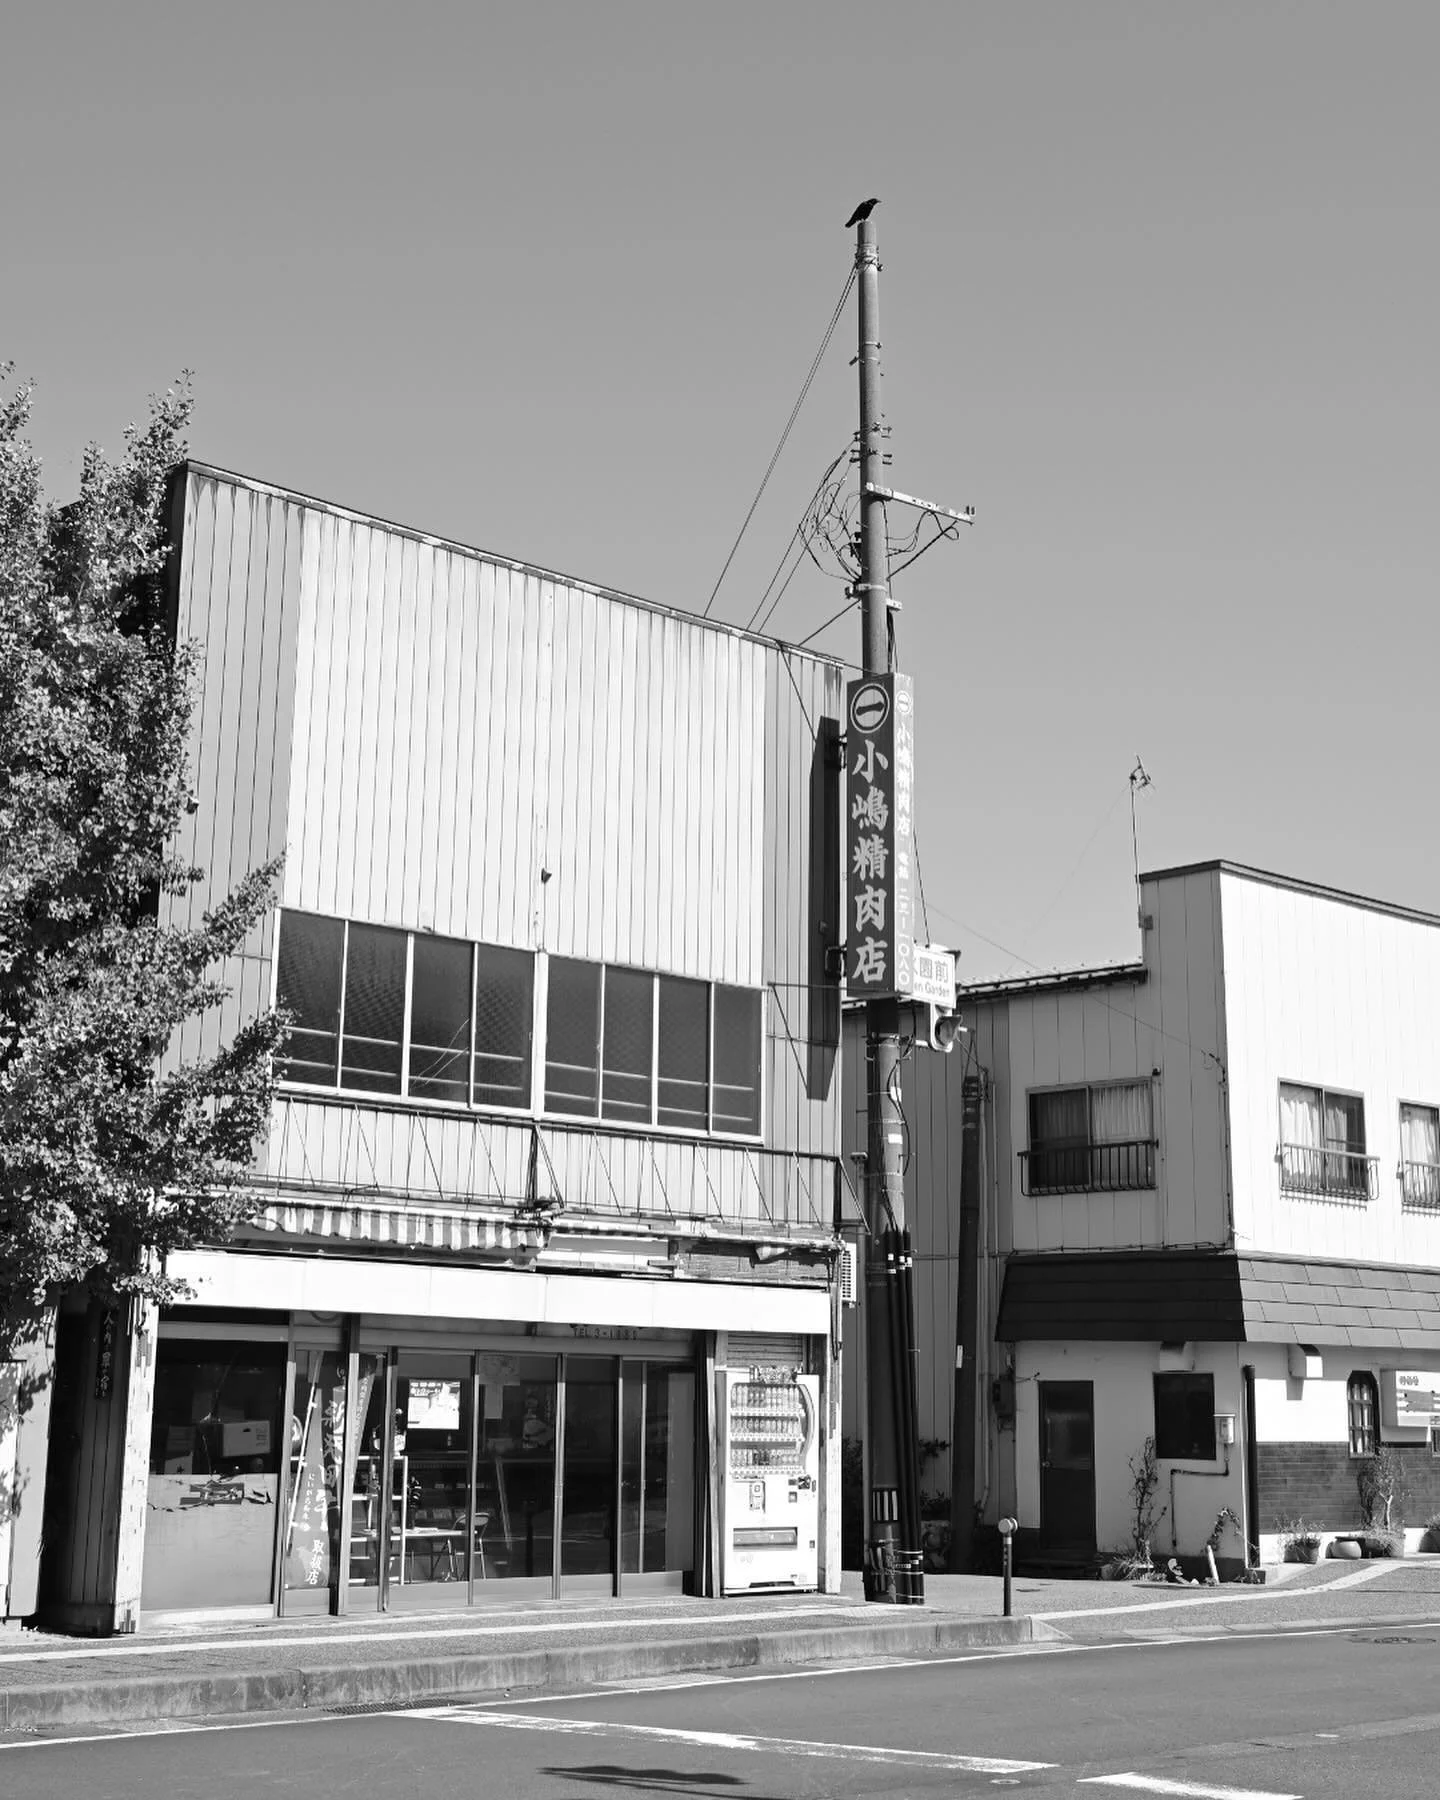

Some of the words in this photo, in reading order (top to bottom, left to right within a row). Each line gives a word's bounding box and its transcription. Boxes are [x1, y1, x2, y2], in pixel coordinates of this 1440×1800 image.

[852, 739, 889, 984] 小嶋精肉店
[913, 957, 949, 983] 園前
